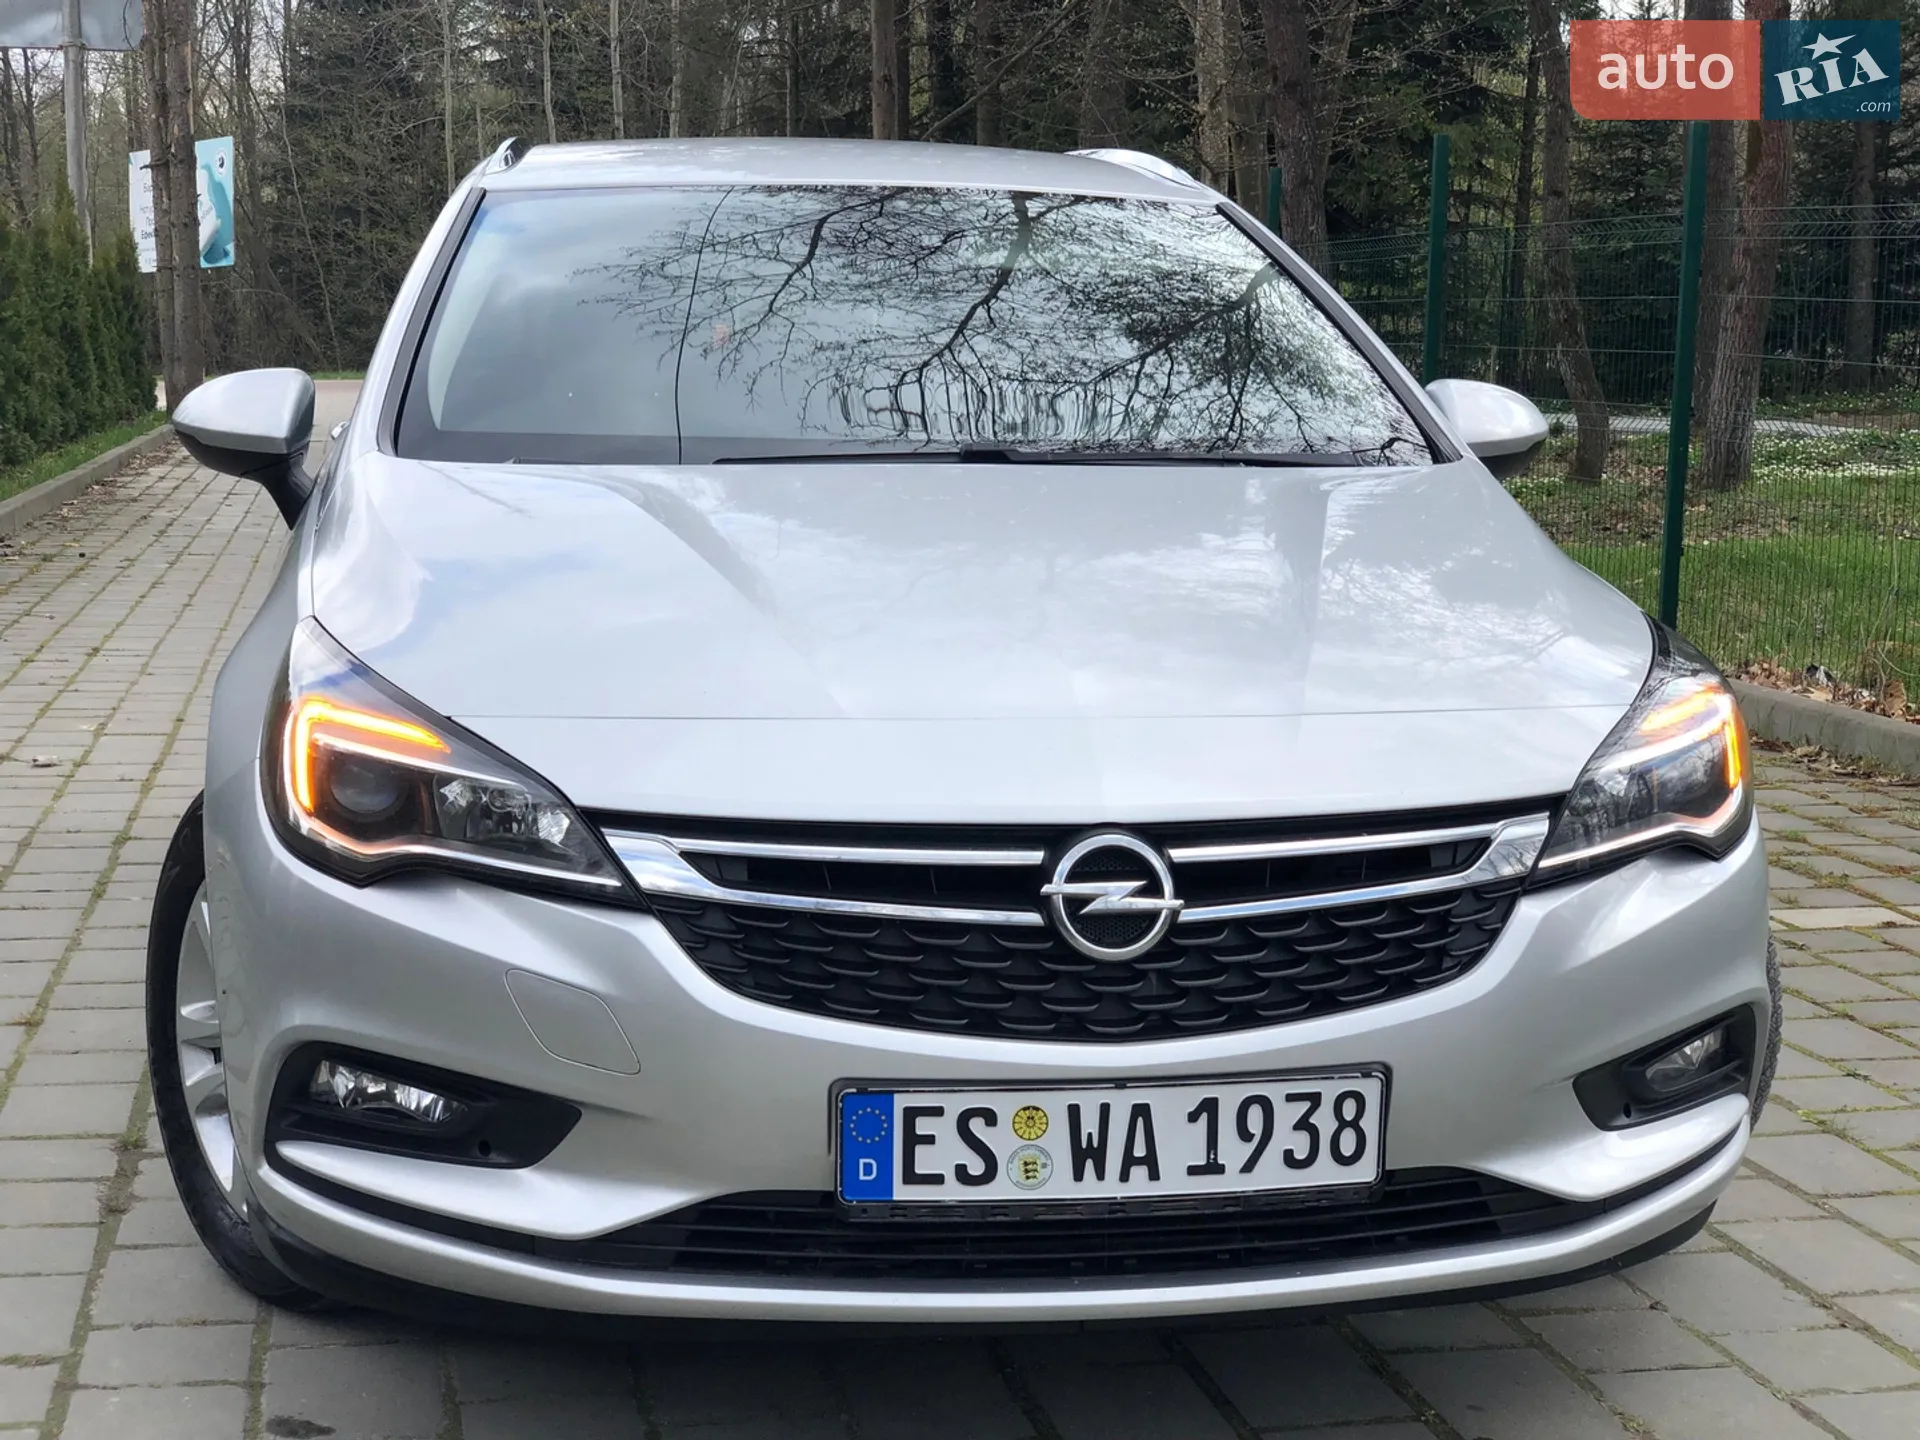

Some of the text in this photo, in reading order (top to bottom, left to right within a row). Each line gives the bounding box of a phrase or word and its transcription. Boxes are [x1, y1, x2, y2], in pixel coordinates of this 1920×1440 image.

[902, 1090, 1366, 1186] ES WA 1938
[859, 1158, 877, 1181] D
